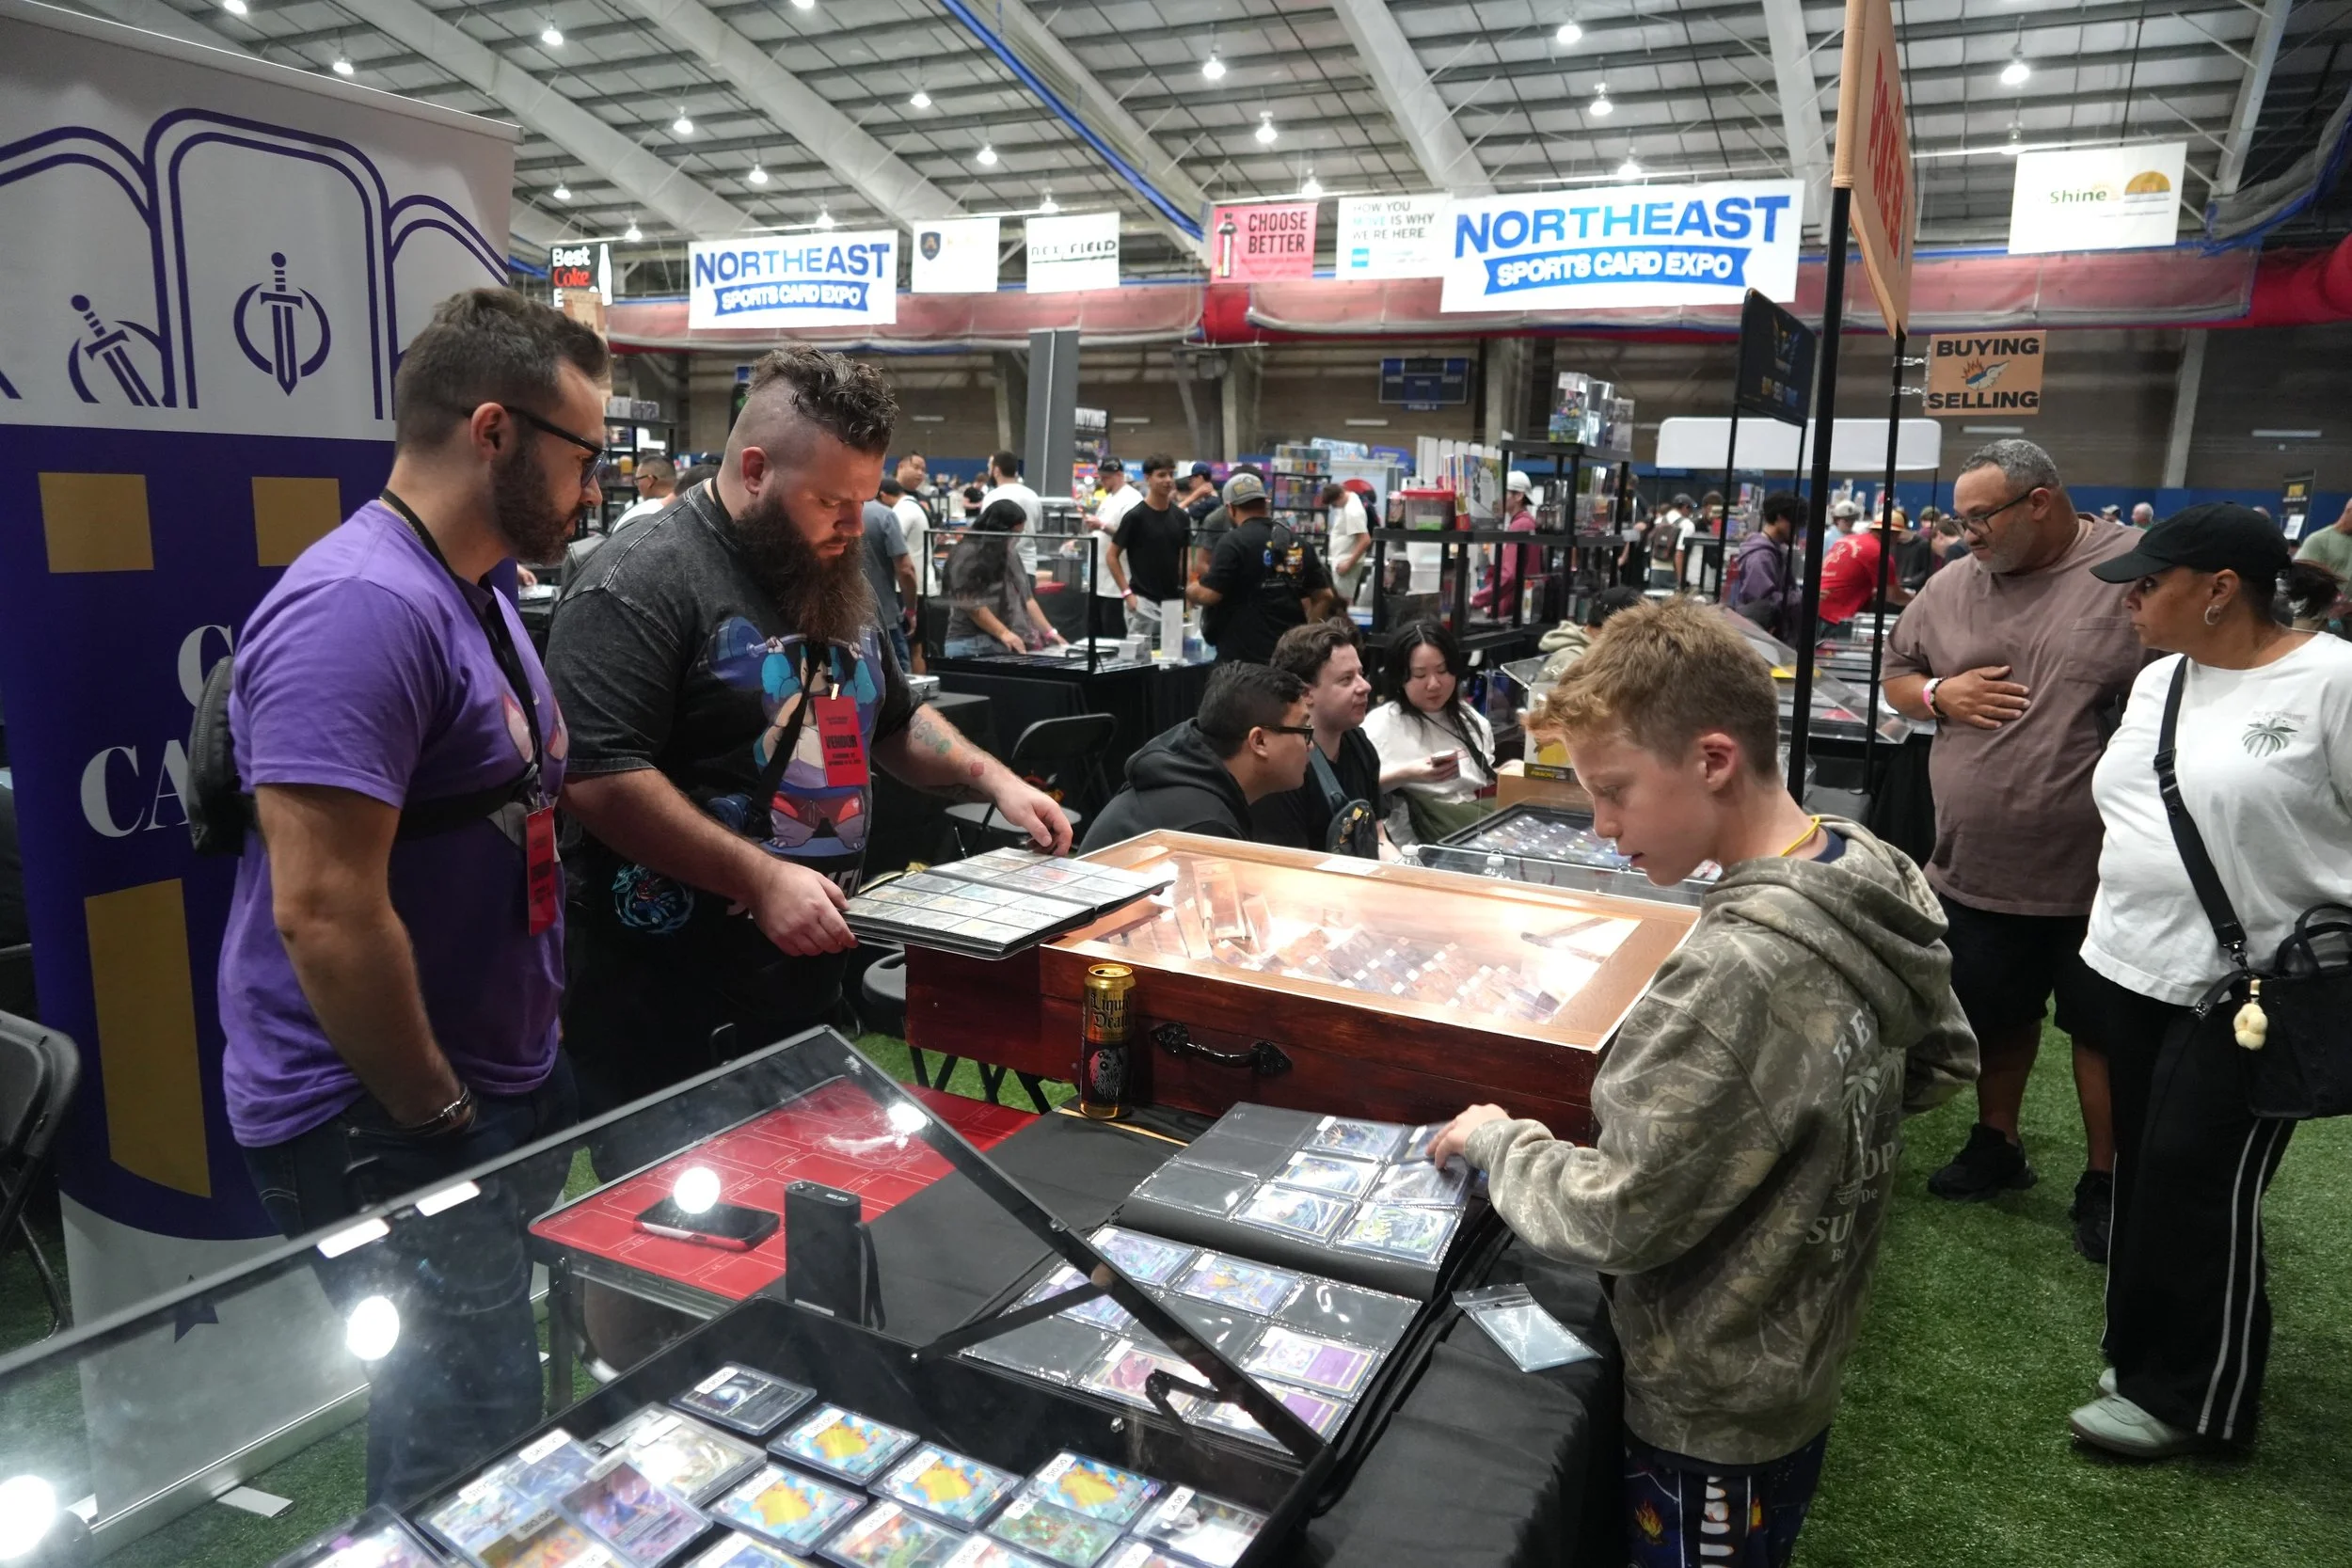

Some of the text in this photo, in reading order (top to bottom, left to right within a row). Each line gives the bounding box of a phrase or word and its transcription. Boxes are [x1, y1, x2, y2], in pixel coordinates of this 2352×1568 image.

[1387, 200, 1411, 213] YOU
[2050, 188, 2107, 204] Shine
[1248, 211, 1308, 232] CHOOSE
[1391, 214, 1402, 226] IS
[1406, 213, 1435, 225] WHY
[1454, 195, 1791, 259] NORTHEAST
[1248, 233, 1305, 254] BETTER
[552, 245, 591, 267] Best
[695, 243, 890, 288] NORTHEAST
[553, 267, 591, 288] Coke
[1497, 250, 1733, 288] SPORTS CARD EXPO
[722, 284, 862, 310] SPORTS CARD EXPO
[1936, 337, 2040, 357] BUYING
[1928, 390, 2039, 409] SELLING
